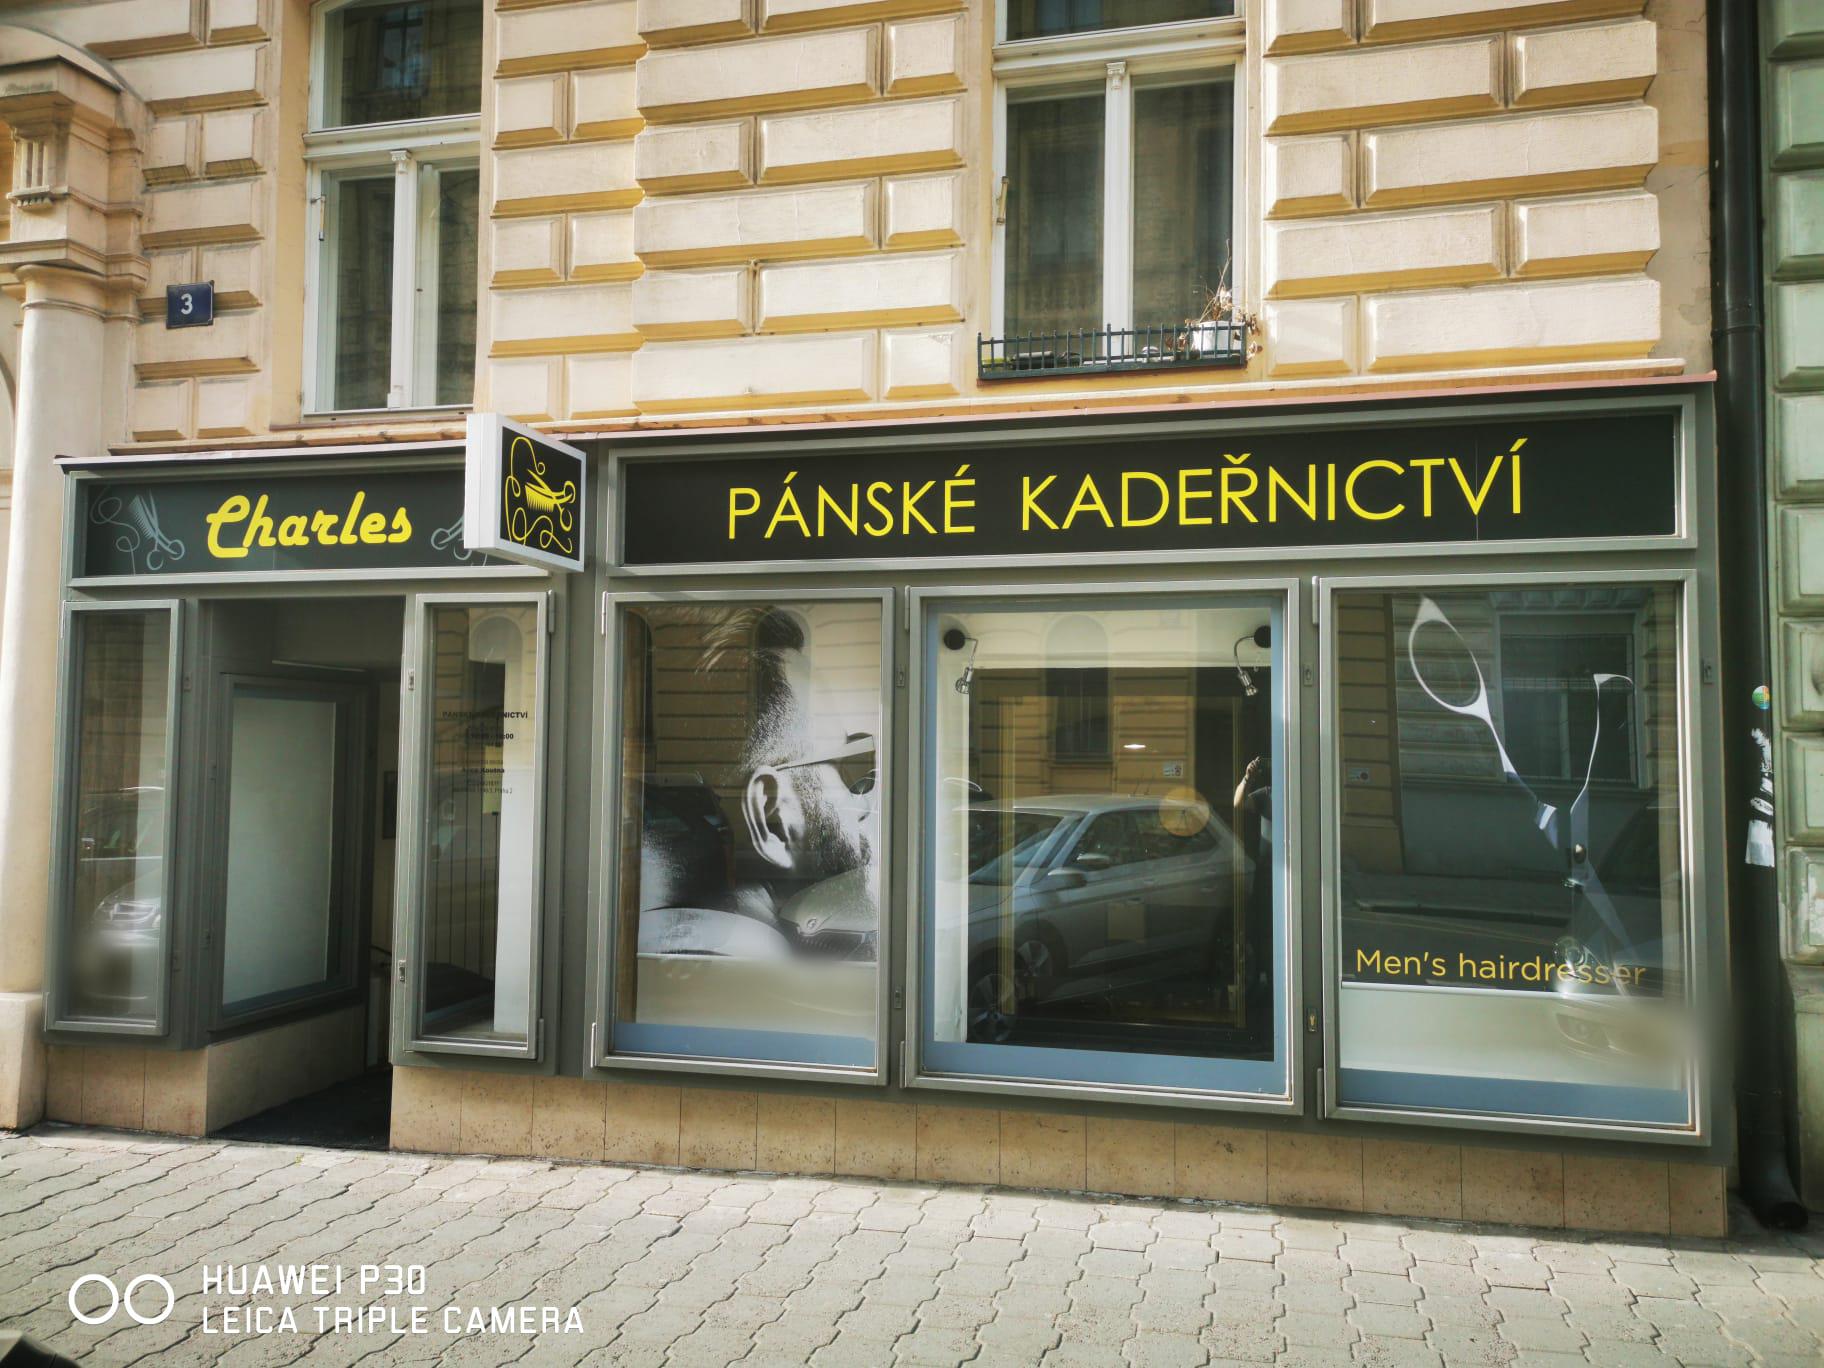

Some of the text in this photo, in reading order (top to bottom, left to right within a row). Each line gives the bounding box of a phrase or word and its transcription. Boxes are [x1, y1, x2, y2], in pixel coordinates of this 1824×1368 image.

[180, 293, 193, 316] 3
[728, 437, 1527, 540] PÁNSKÉ KADEŘNICTVÍ
[206, 490, 413, 559] Charles
[1356, 948, 1648, 986] Men's hairdresser
